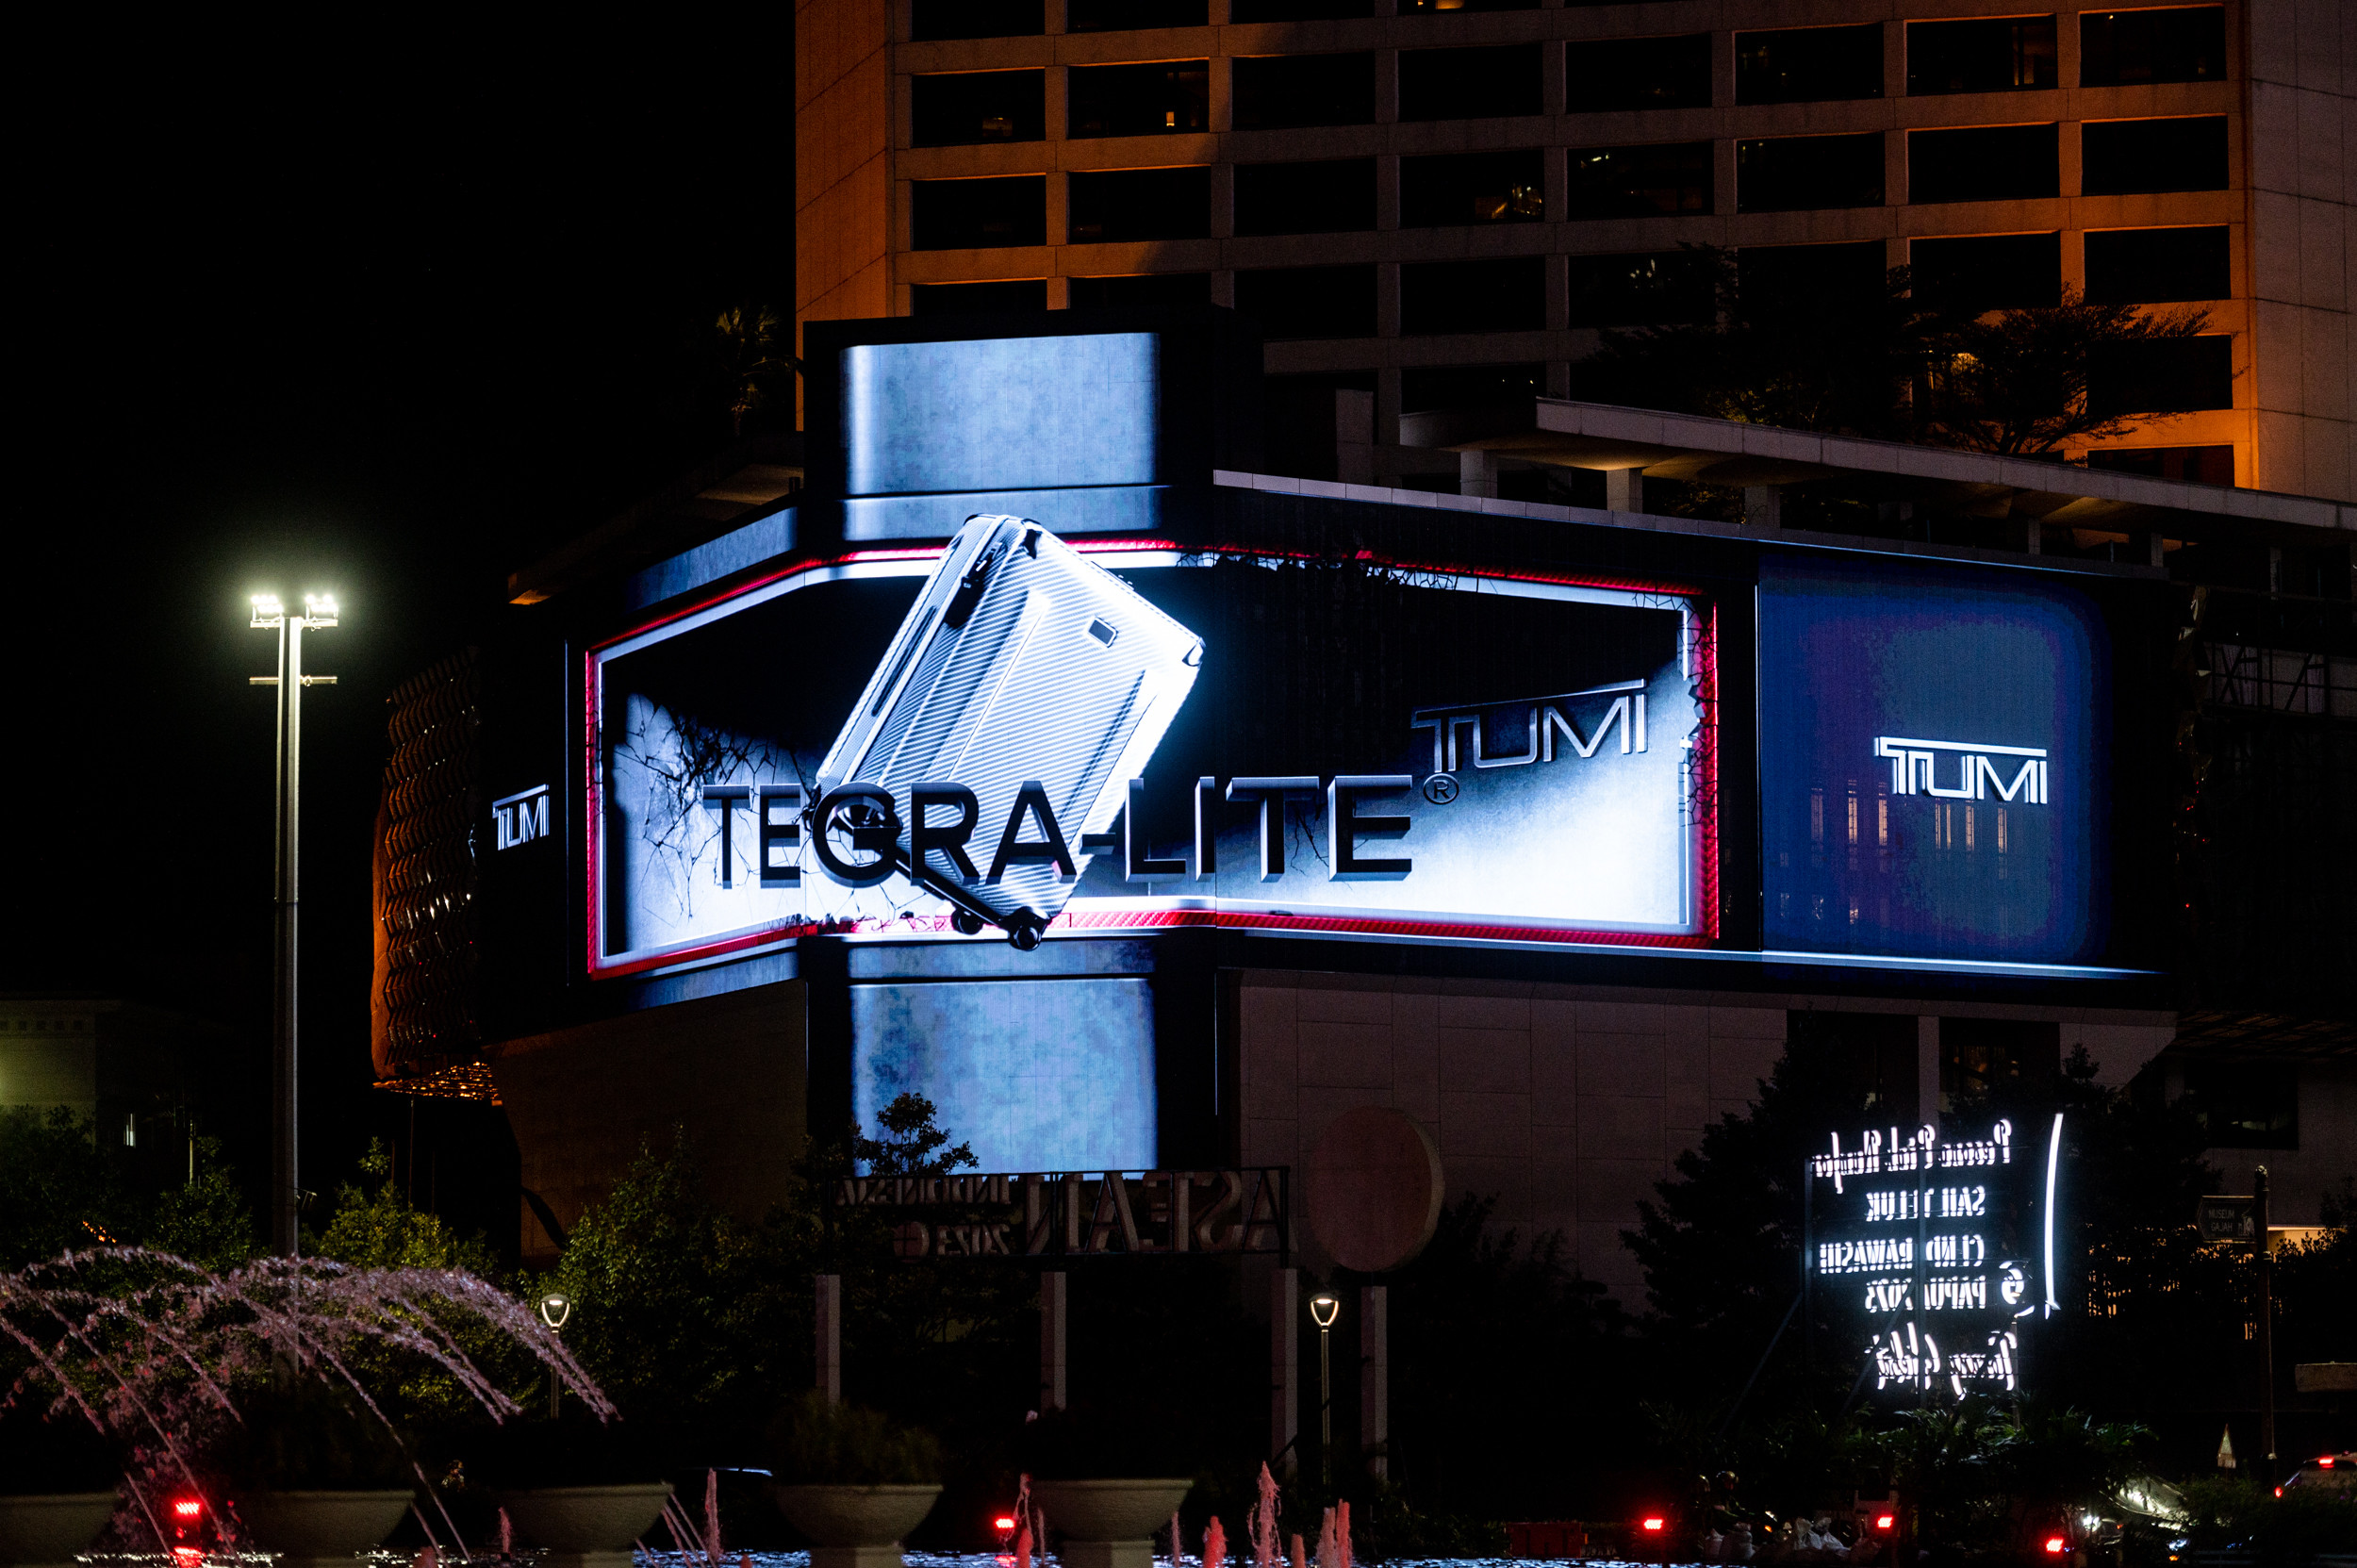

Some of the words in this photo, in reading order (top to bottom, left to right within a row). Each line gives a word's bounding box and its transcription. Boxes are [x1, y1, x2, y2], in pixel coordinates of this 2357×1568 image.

[1411, 678, 1648, 773] TUMI
[1874, 736, 2047, 804] TUMI
[492, 784, 549, 850] TUMI
